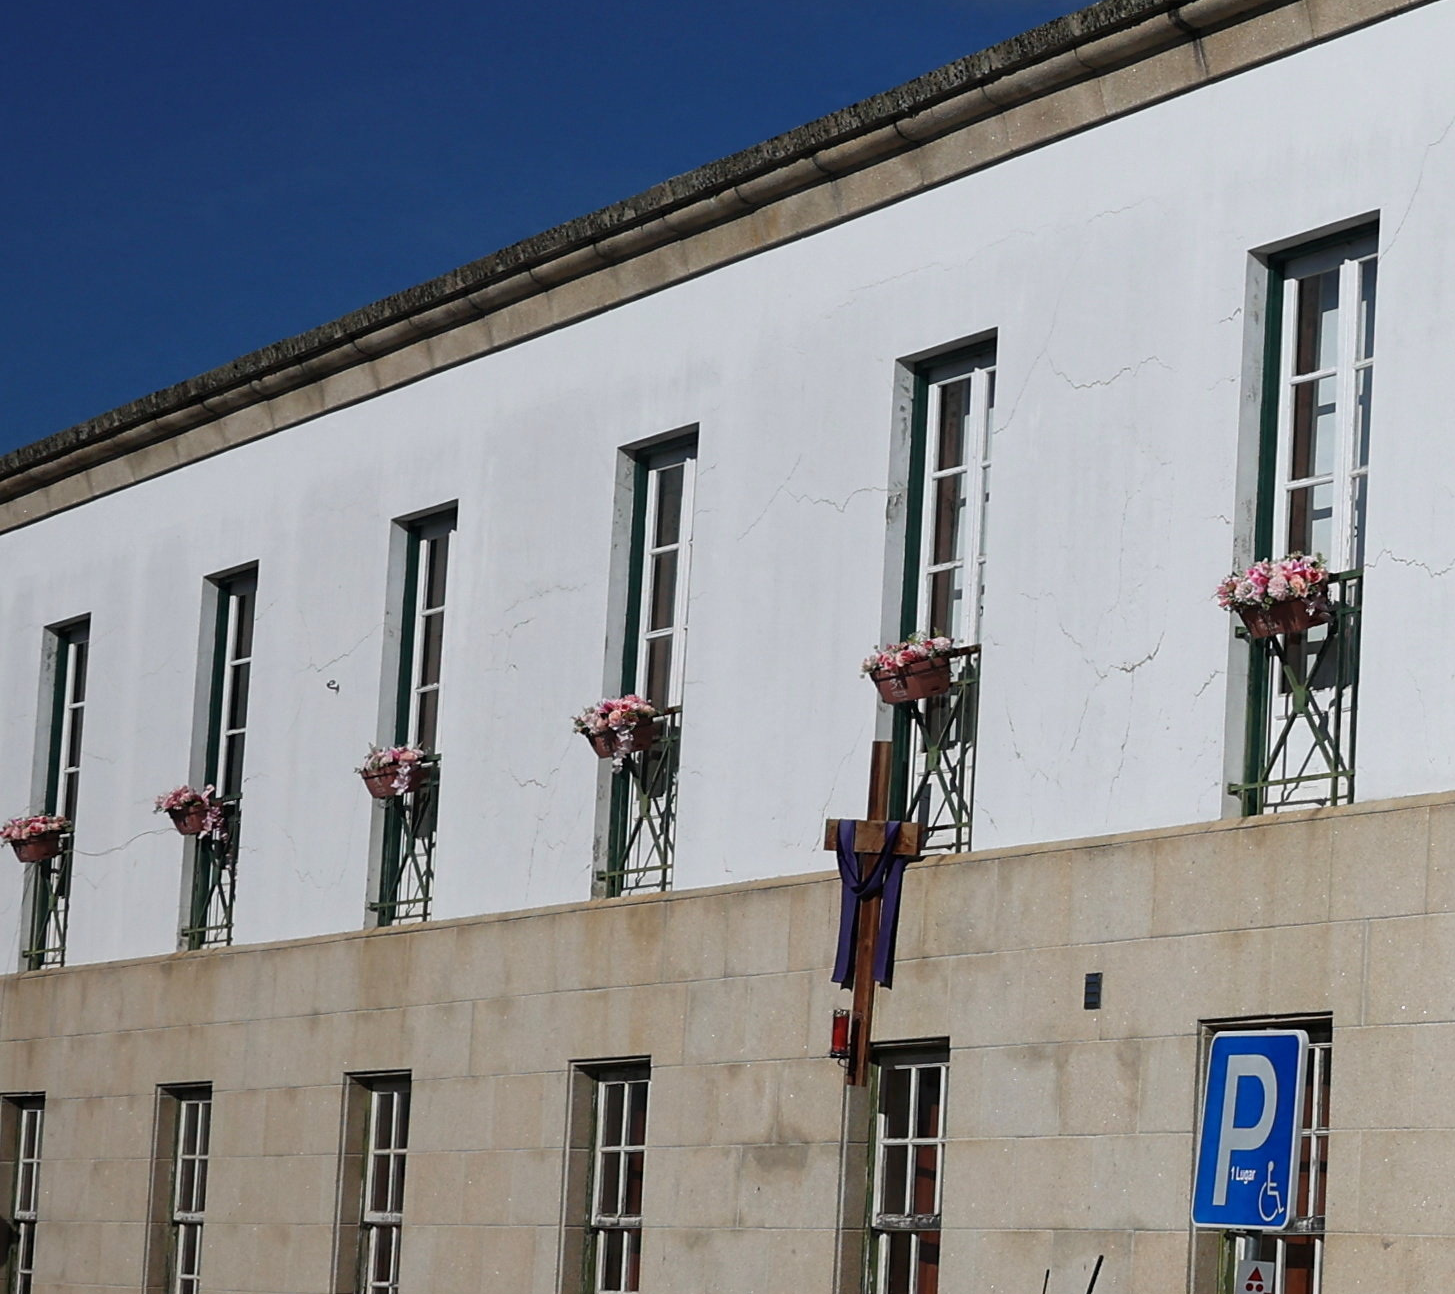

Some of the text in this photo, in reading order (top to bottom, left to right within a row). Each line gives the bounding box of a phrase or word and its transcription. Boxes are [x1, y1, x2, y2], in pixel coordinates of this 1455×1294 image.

[1212, 1054, 1278, 1206] P
[1231, 1166, 1256, 1185] 1 Lugar
